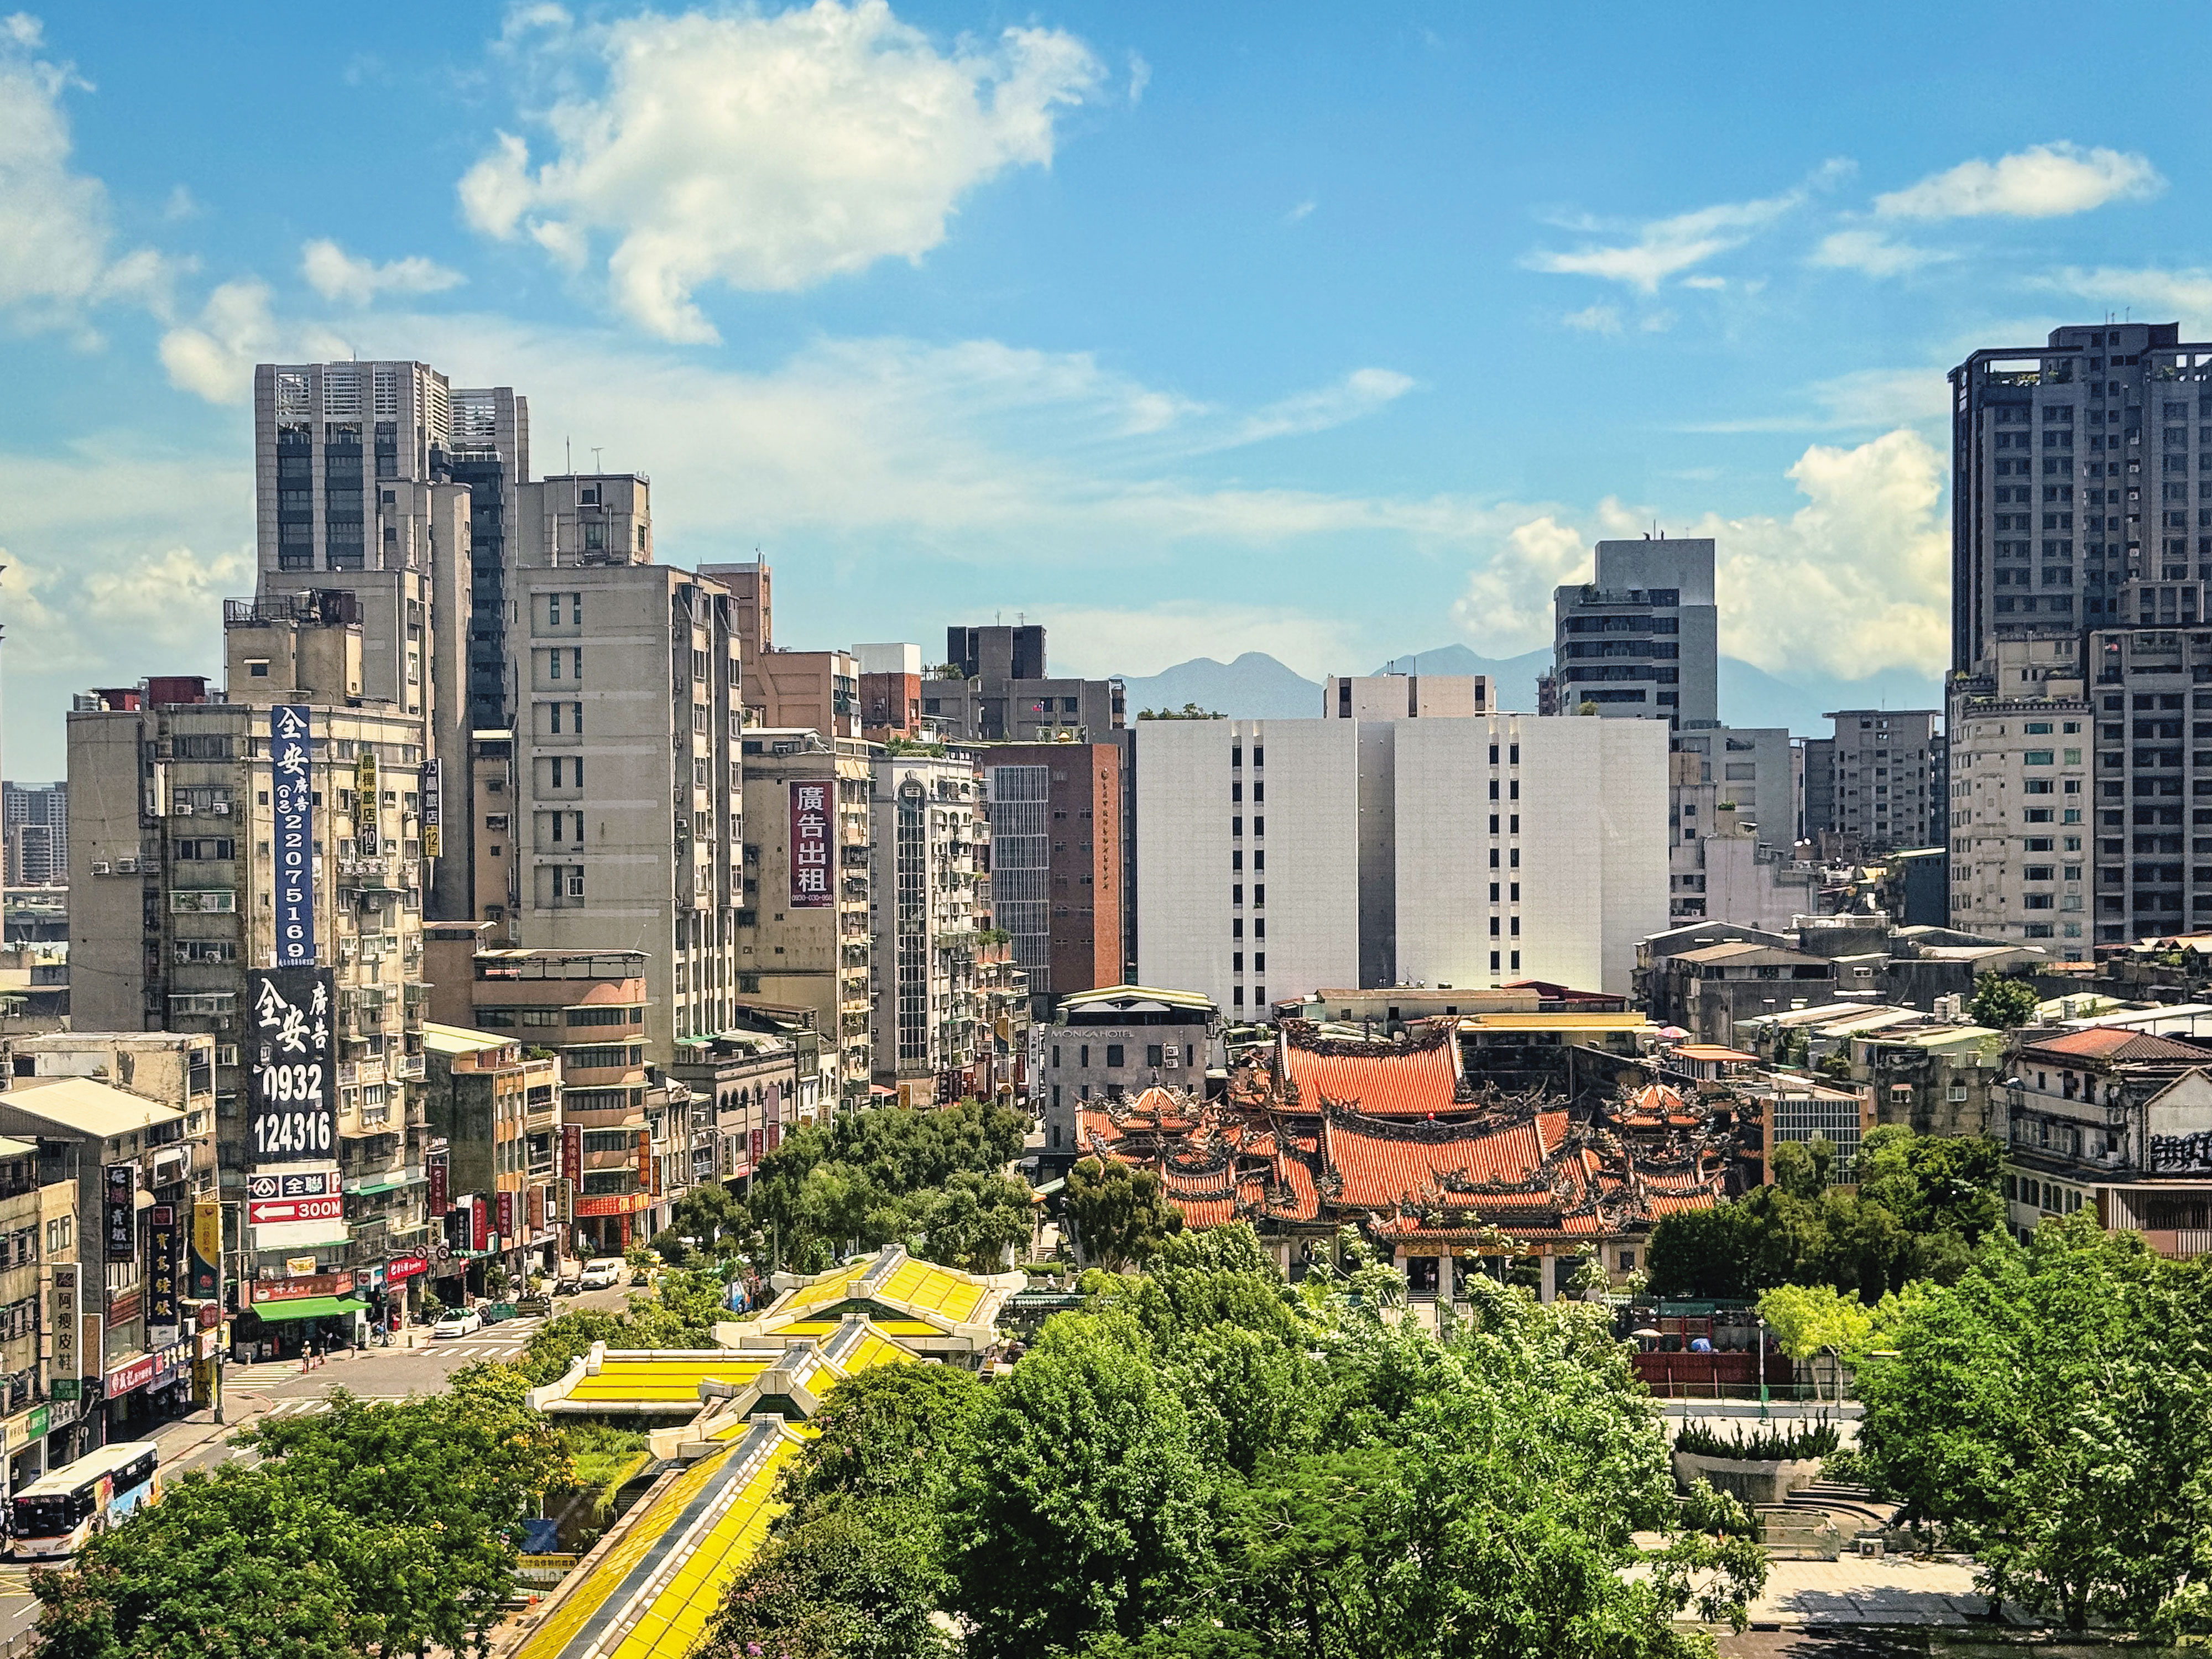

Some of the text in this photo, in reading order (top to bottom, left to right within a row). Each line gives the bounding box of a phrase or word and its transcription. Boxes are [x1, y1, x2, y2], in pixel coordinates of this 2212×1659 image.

[277, 707, 309, 775] 全安
[293, 776, 309, 812] 廣告
[797, 786, 827, 893] 廣告出租
[285, 815, 304, 957] 22075169
[254, 978, 311, 1053] 全安
[309, 980, 329, 1049] 廣告
[1052, 1030, 1134, 1038] MONKA HOTEL
[262, 1064, 322, 1101] 0932
[255, 1112, 330, 1152] 124316
[284, 1176, 324, 1195] 全聯
[58, 1292, 72, 1371] 阿瘦皮鞋
